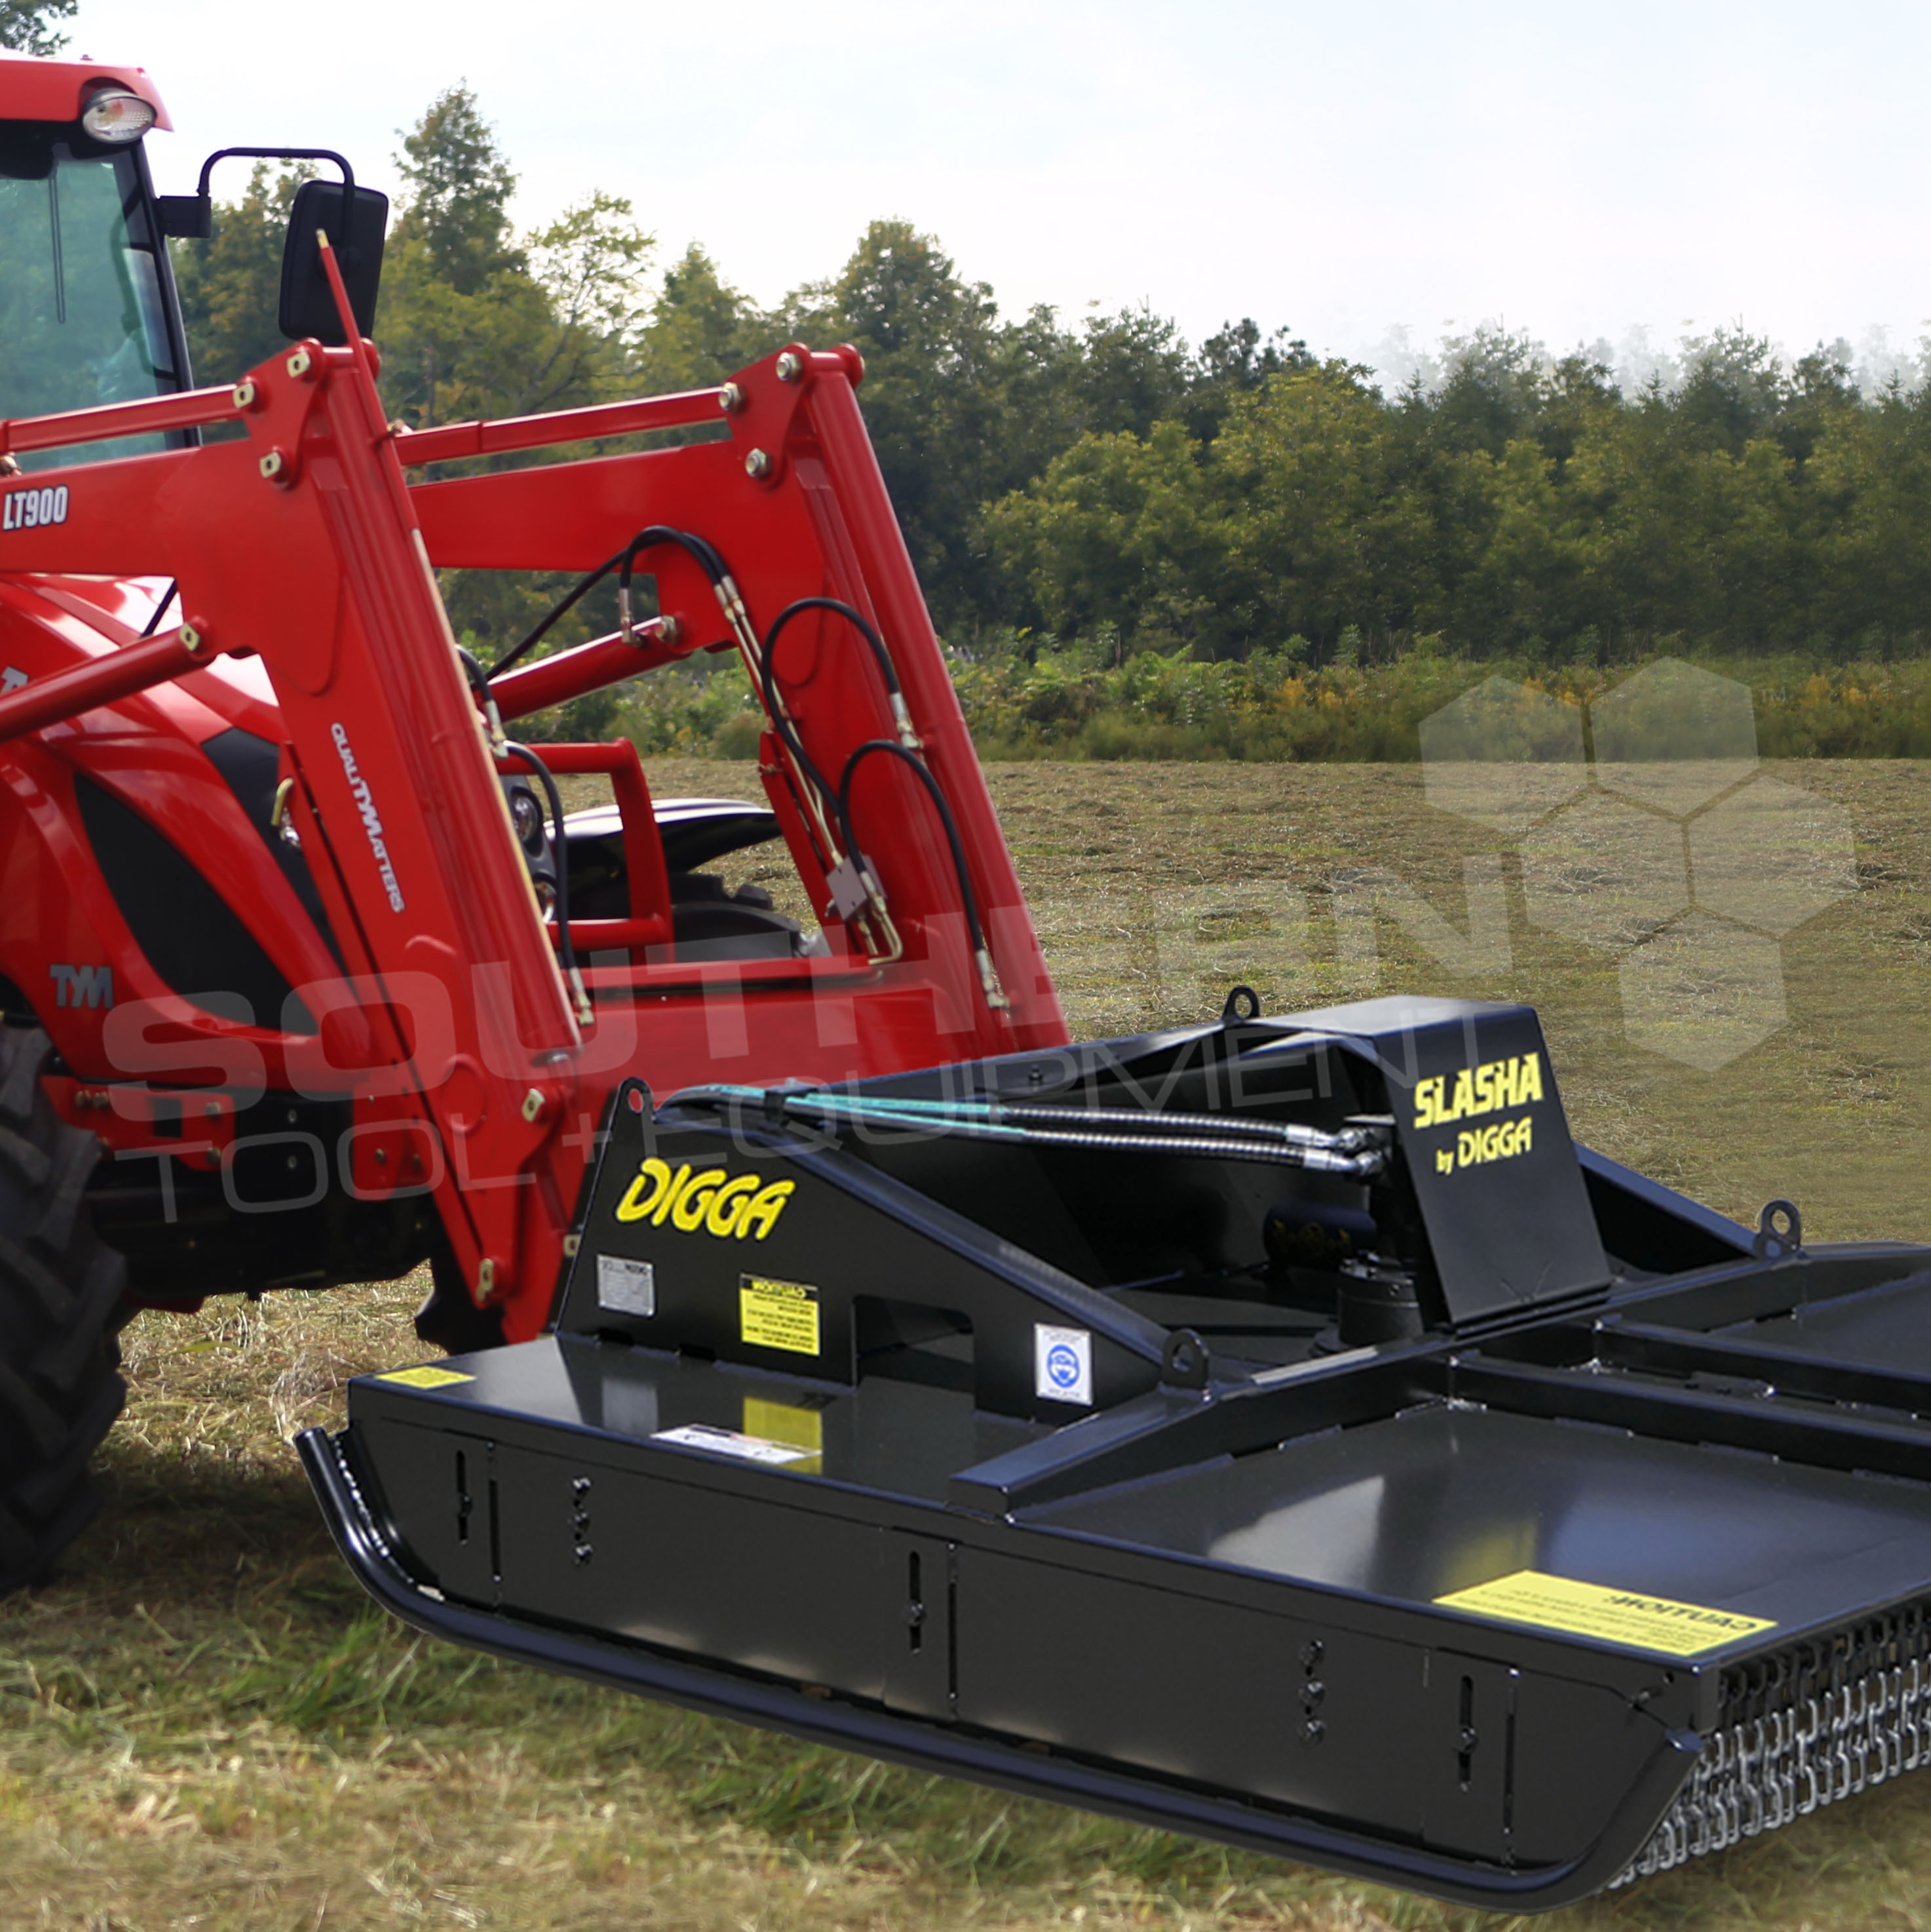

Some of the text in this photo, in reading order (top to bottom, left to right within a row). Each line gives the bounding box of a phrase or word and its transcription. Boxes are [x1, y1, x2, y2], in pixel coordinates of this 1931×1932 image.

[3, 485, 69, 530] LT900
[49, 963, 114, 1009] TYM
[1413, 1052, 1544, 1129] SLASHA
[1435, 1115, 1533, 1175] by DIGGA
[616, 1157, 797, 1240] DIGGA
